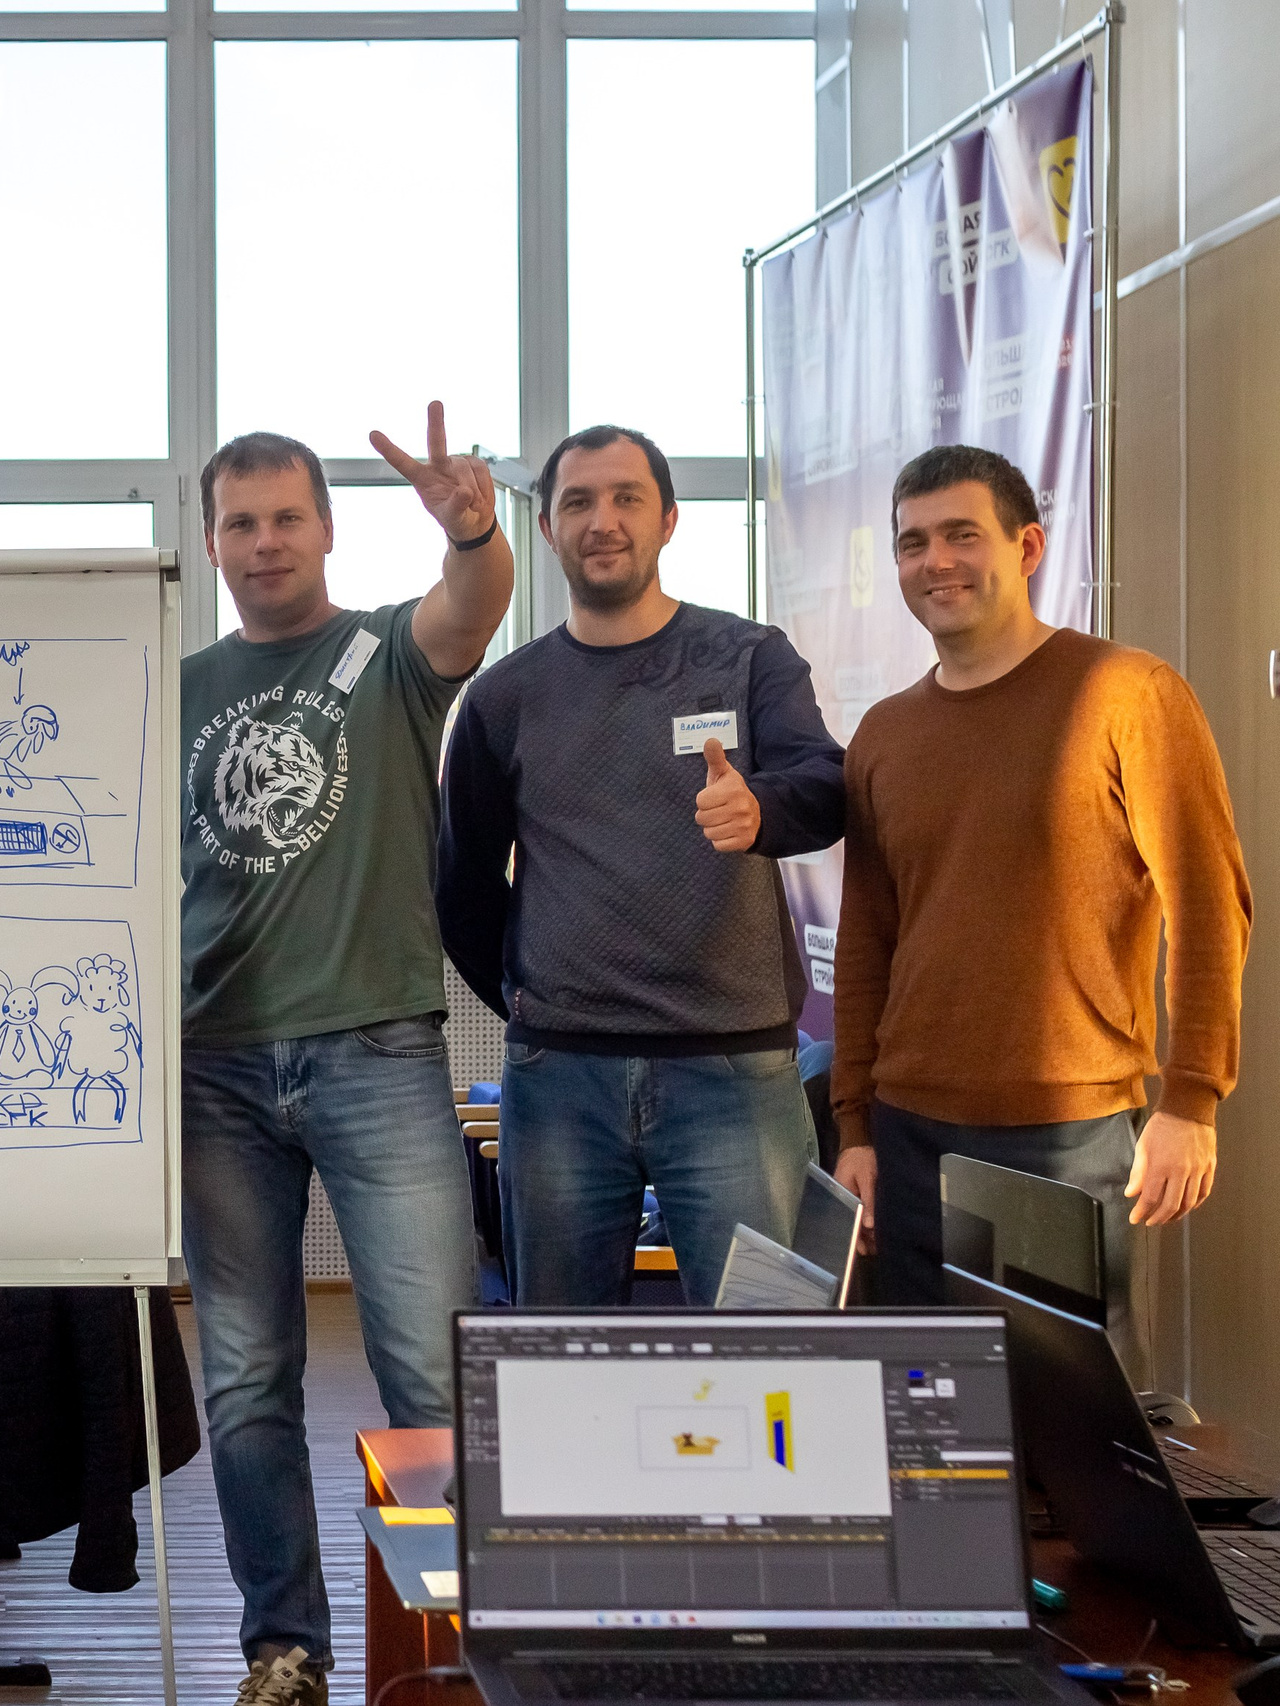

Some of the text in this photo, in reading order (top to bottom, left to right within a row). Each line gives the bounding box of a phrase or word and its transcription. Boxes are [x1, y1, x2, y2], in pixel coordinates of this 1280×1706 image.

[195, 684, 346, 752] BREAKING RULES
[193, 774, 349, 875] PART OF THE RBELLION
